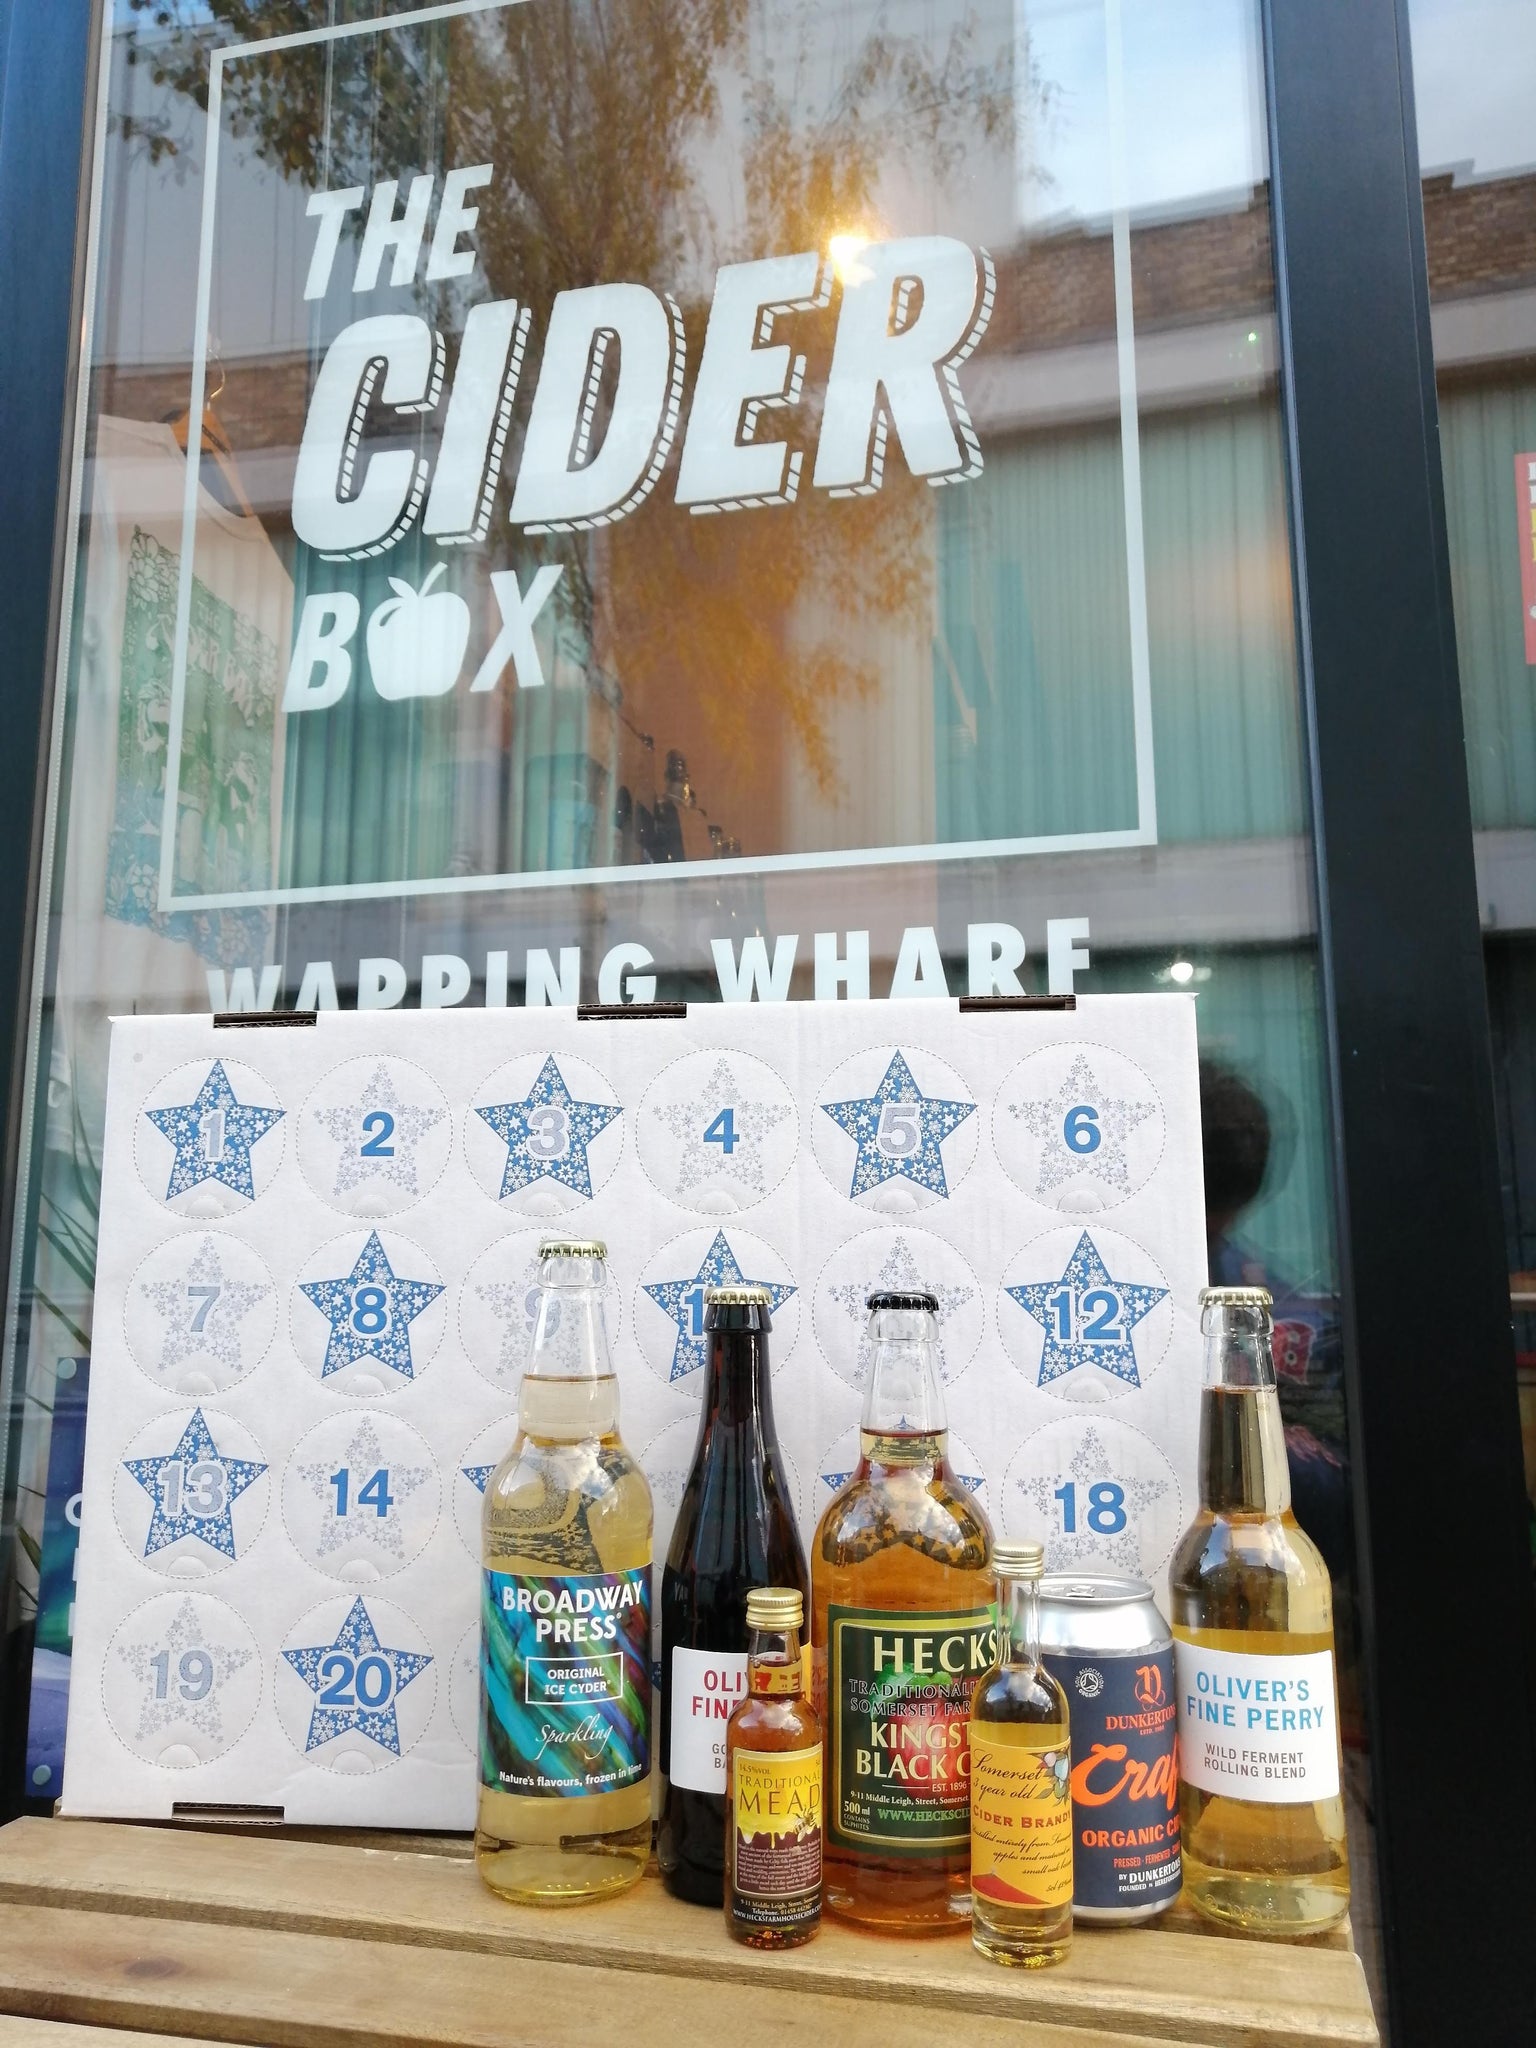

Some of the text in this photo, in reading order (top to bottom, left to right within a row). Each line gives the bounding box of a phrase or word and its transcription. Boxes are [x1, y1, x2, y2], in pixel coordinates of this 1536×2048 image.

[303, 163, 494, 300] THE
[291, 235, 997, 562] CIDER
[206, 917, 1090, 1011] WAPPING WHARF
[200, 1111, 226, 1160] 1
[361, 1110, 395, 1157] 2
[528, 1109, 569, 1158] 3
[702, 1108, 740, 1154] 4
[879, 1105, 919, 1156] 5
[1062, 1105, 1101, 1154] 6
[186, 1286, 221, 1333] 7
[354, 1286, 390, 1336] 8
[523, 1287, 562, 1339] 9
[684, 1288, 705, 1337] 1
[1049, 1289, 1122, 1341] 12
[160, 1463, 226, 1516] 13
[329, 1468, 394, 1517] 14
[1054, 1481, 1128, 1535] 18
[503, 1580, 643, 1614] BROADWAY
[873, 1629, 998, 1673] HECKS
[149, 1650, 214, 1701] 19
[318, 1656, 394, 1706] 20
[544, 1684, 565, 1695] ICE
[547, 1667, 605, 1680] ORIGINAL
[704, 1670, 749, 1692] OLI
[1196, 1671, 1310, 1701] OLIVER'S
[850, 1697, 971, 1717] SOMERSET FAR
[1187, 1695, 1323, 1731] FINE PERRY
[535, 1713, 614, 1761] Sparkling
[1206, 1743, 1304, 1763] WILD FERMENT
[500, 1771, 535, 1786] Nature's
[537, 1775, 583, 1788] flavours,
[585, 1773, 617, 1786] frozen
[618, 1769, 627, 1779] in
[739, 1769, 820, 1789] TRADITIONAL
[857, 1749, 948, 1780] BLACK
[973, 1748, 1043, 1781] Somerset
[1204, 1757, 1306, 1779] ROLLING BLEND
[739, 1783, 821, 1815] MEAD
[850, 1790, 864, 1800] 9-11
[866, 1792, 890, 1804] Middle
[891, 1795, 914, 1806] Leigh,
[915, 1797, 939, 1806] Street,
[932, 1782, 967, 1793] EST. 1896
[973, 1777, 1038, 1801] 3 year old
[844, 1801, 871, 1816] 500 ml
[1082, 1824, 1164, 1847] ORGANIC
[993, 1851, 1018, 1863] apples
[1020, 1852, 1040, 1862] and
[1022, 1865, 1048, 1875] small
[1113, 1856, 1141, 1868] PRESSED
